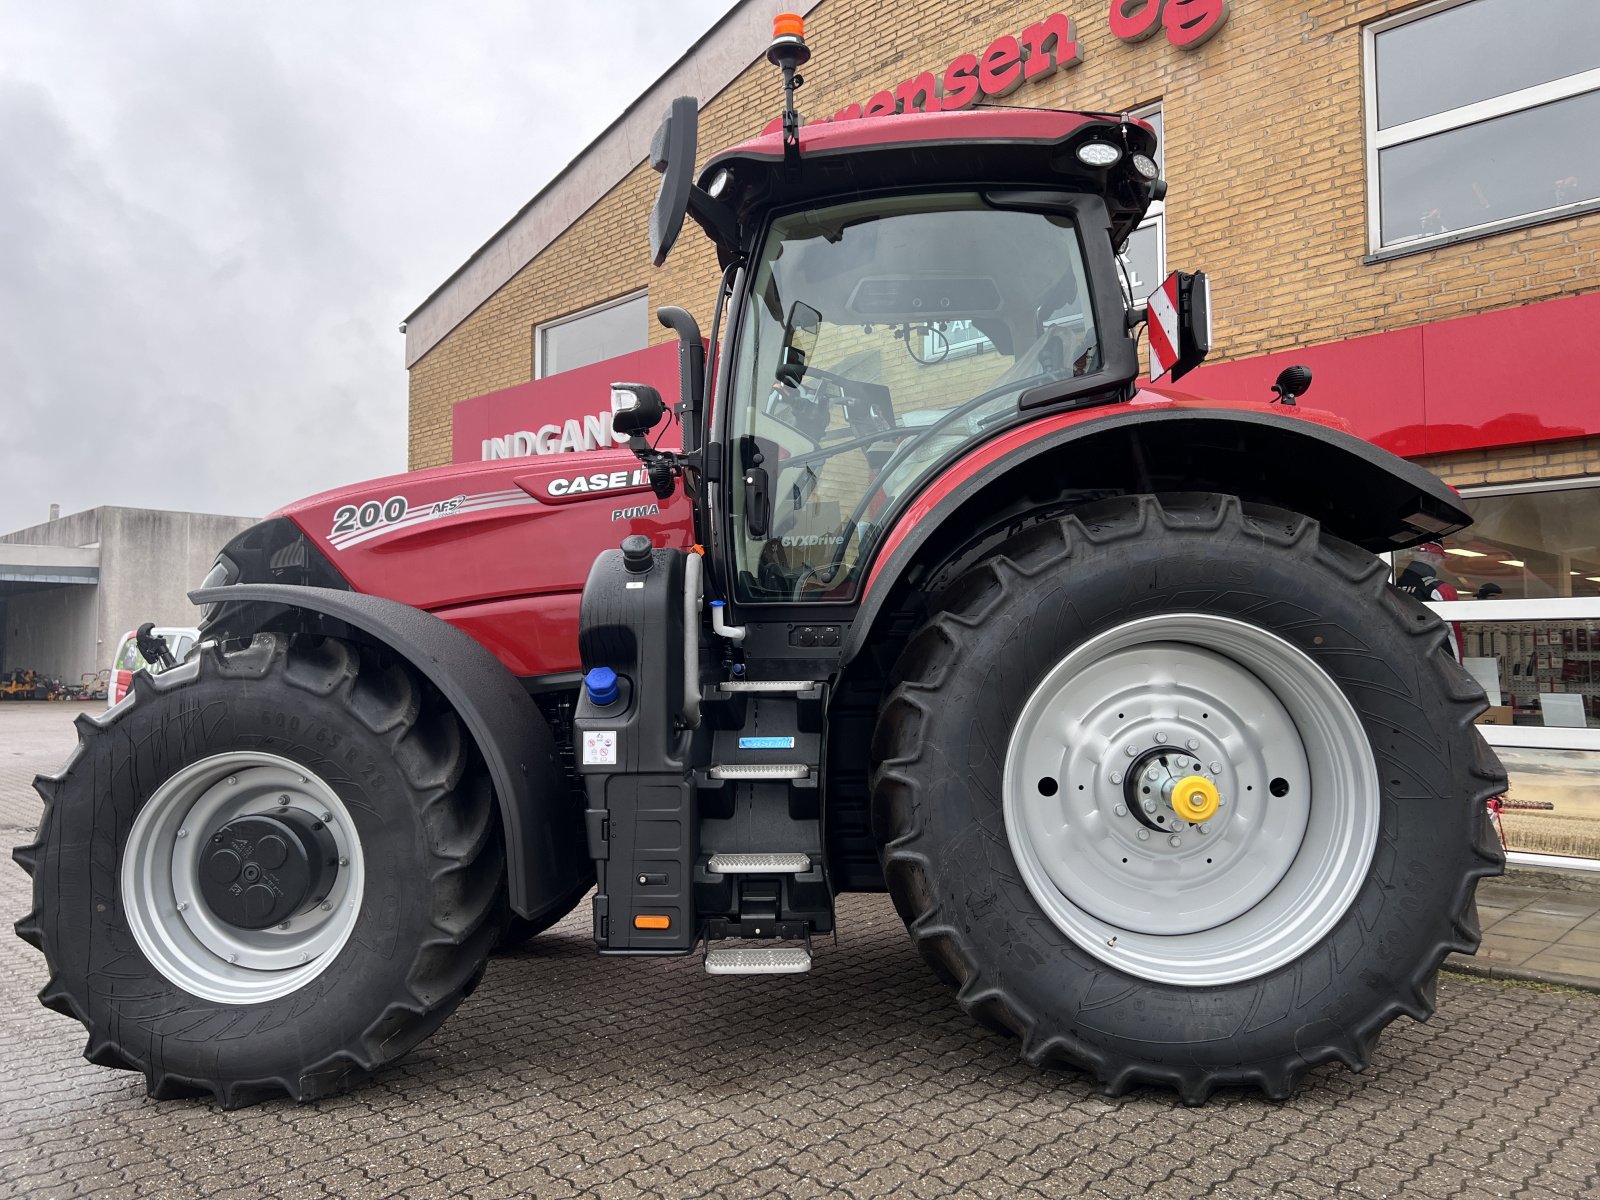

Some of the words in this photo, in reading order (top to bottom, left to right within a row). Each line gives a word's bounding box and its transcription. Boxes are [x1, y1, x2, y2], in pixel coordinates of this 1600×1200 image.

[547, 471, 628, 496] CASE
[331, 496, 408, 535] 200
[431, 499, 458, 514] AFS
[612, 504, 659, 521] PUMA
